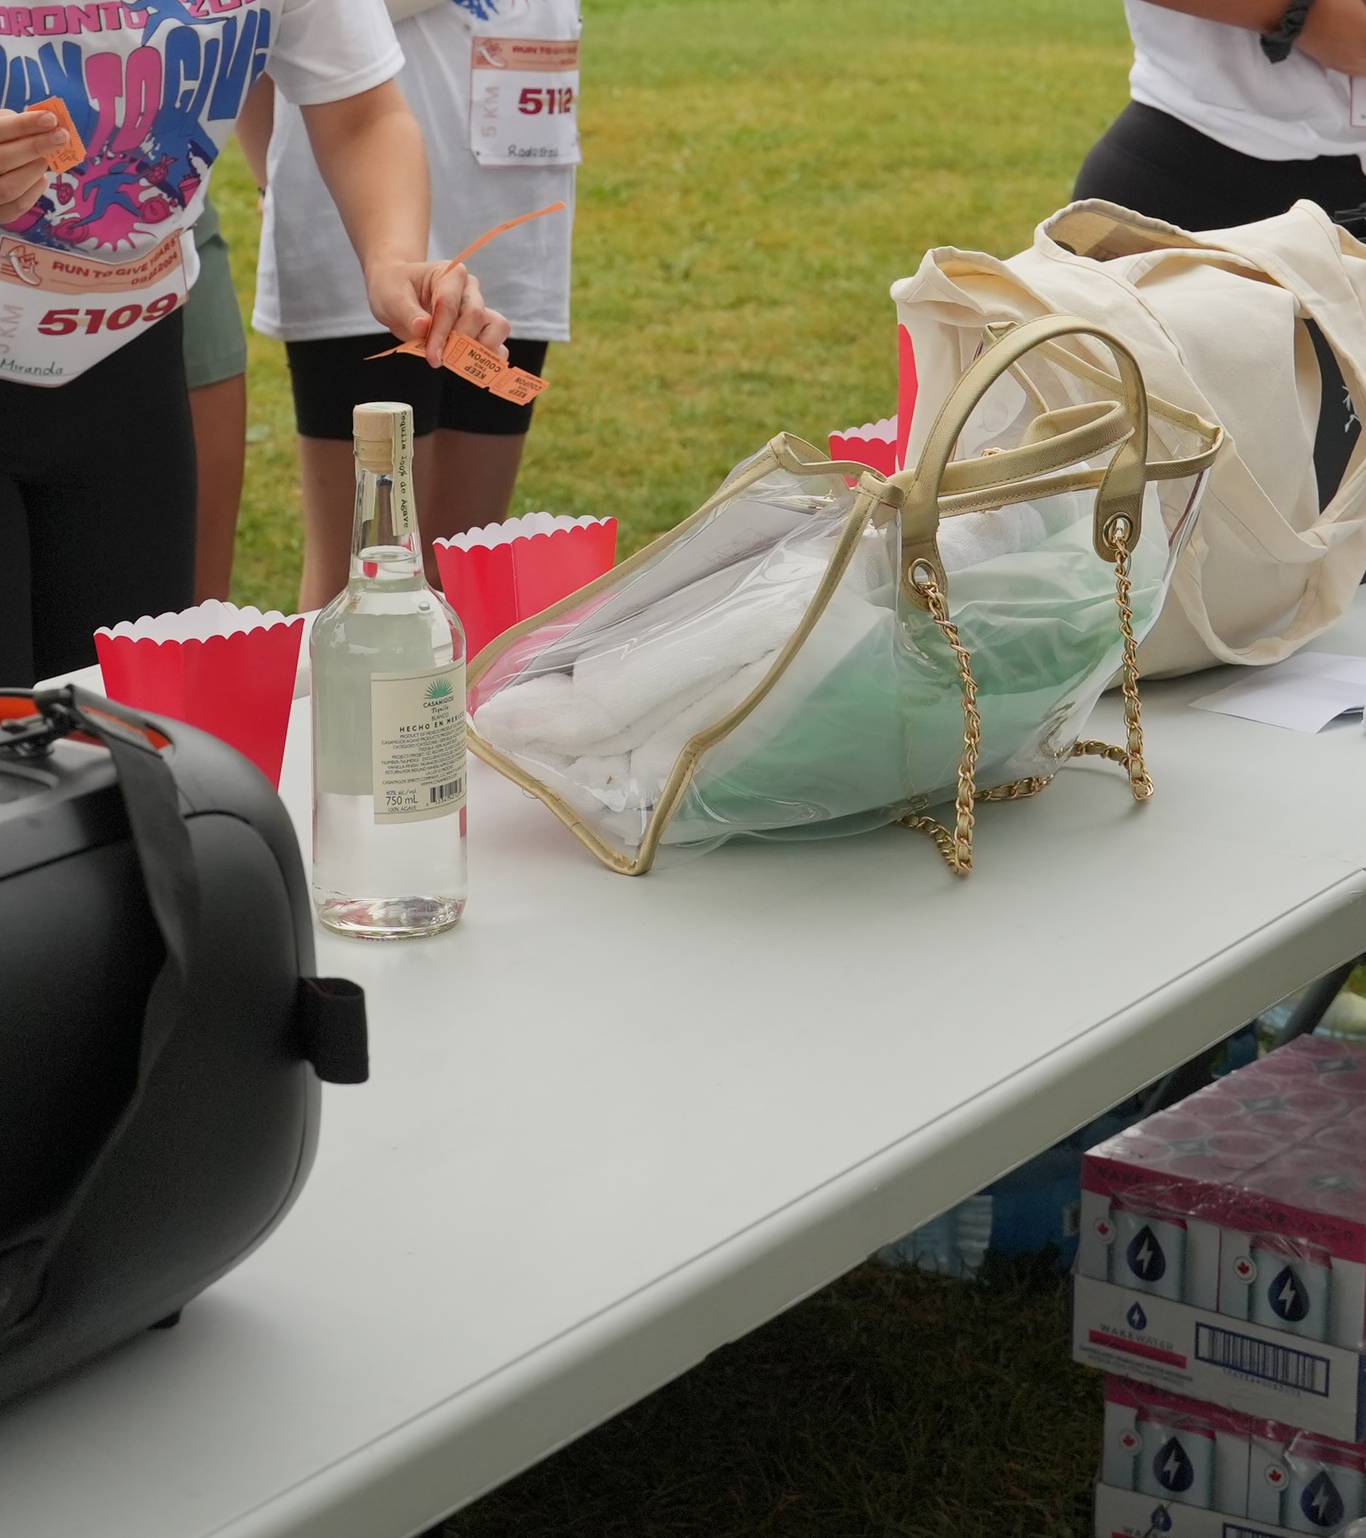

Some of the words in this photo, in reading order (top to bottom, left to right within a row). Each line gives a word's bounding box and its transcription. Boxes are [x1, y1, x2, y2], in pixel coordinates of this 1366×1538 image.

[84, 45, 163, 155] TO
[518, 86, 573, 115] 5112
[52, 260, 90, 277] RUN
[93, 269, 113, 279] TO
[116, 262, 149, 277] GIVE
[38, 292, 179, 336] 5109
[0, 358, 64, 377] Miranda
[467, 348, 502, 374] COUPON
[464, 365, 488, 380] KEEP
[508, 388, 529, 399] KEEP
[399, 482, 407, 494] de
[423, 695, 454, 708] CASAMIGOS
[399, 723, 431, 733] HECHO
[434, 720, 444, 728] EN
[385, 796, 403, 806] 750
[404, 795, 419, 804] mL
